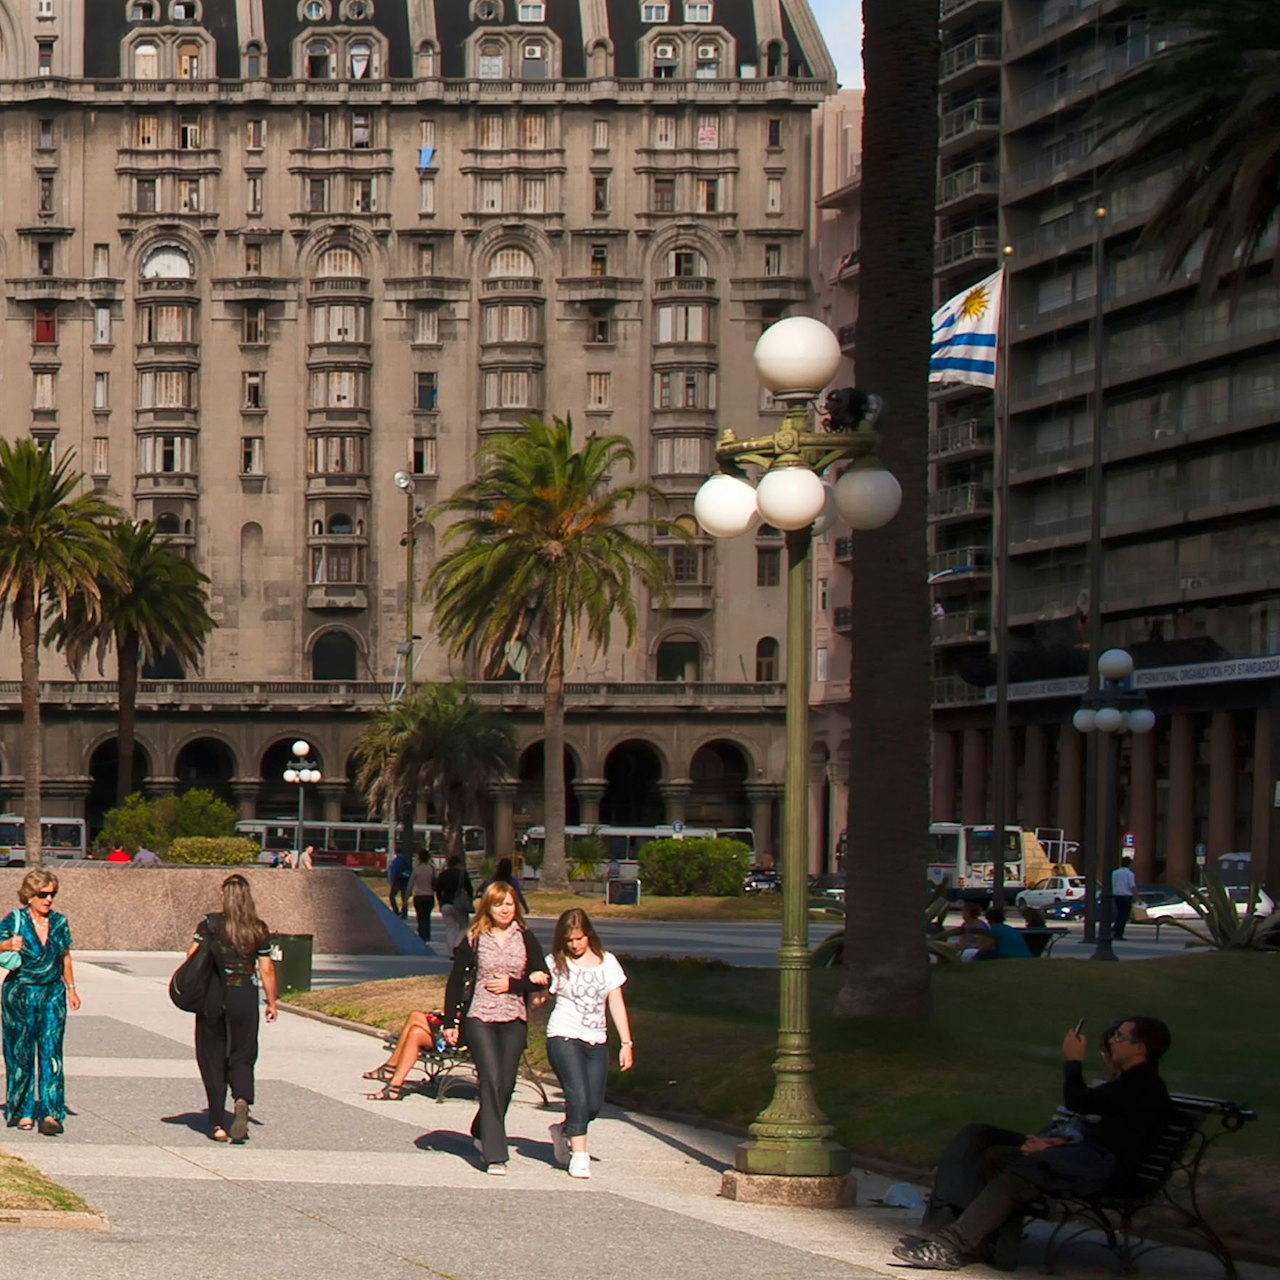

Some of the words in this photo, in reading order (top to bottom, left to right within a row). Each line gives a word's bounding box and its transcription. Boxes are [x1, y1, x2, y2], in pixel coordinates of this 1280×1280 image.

[1180, 665, 1223, 682] ORGANIZATION
[1223, 663, 1237, 677] FOR
[1125, 834, 1134, 846] E
[570, 968, 605, 985] YOU
[571, 984, 607, 1001] LOOK
